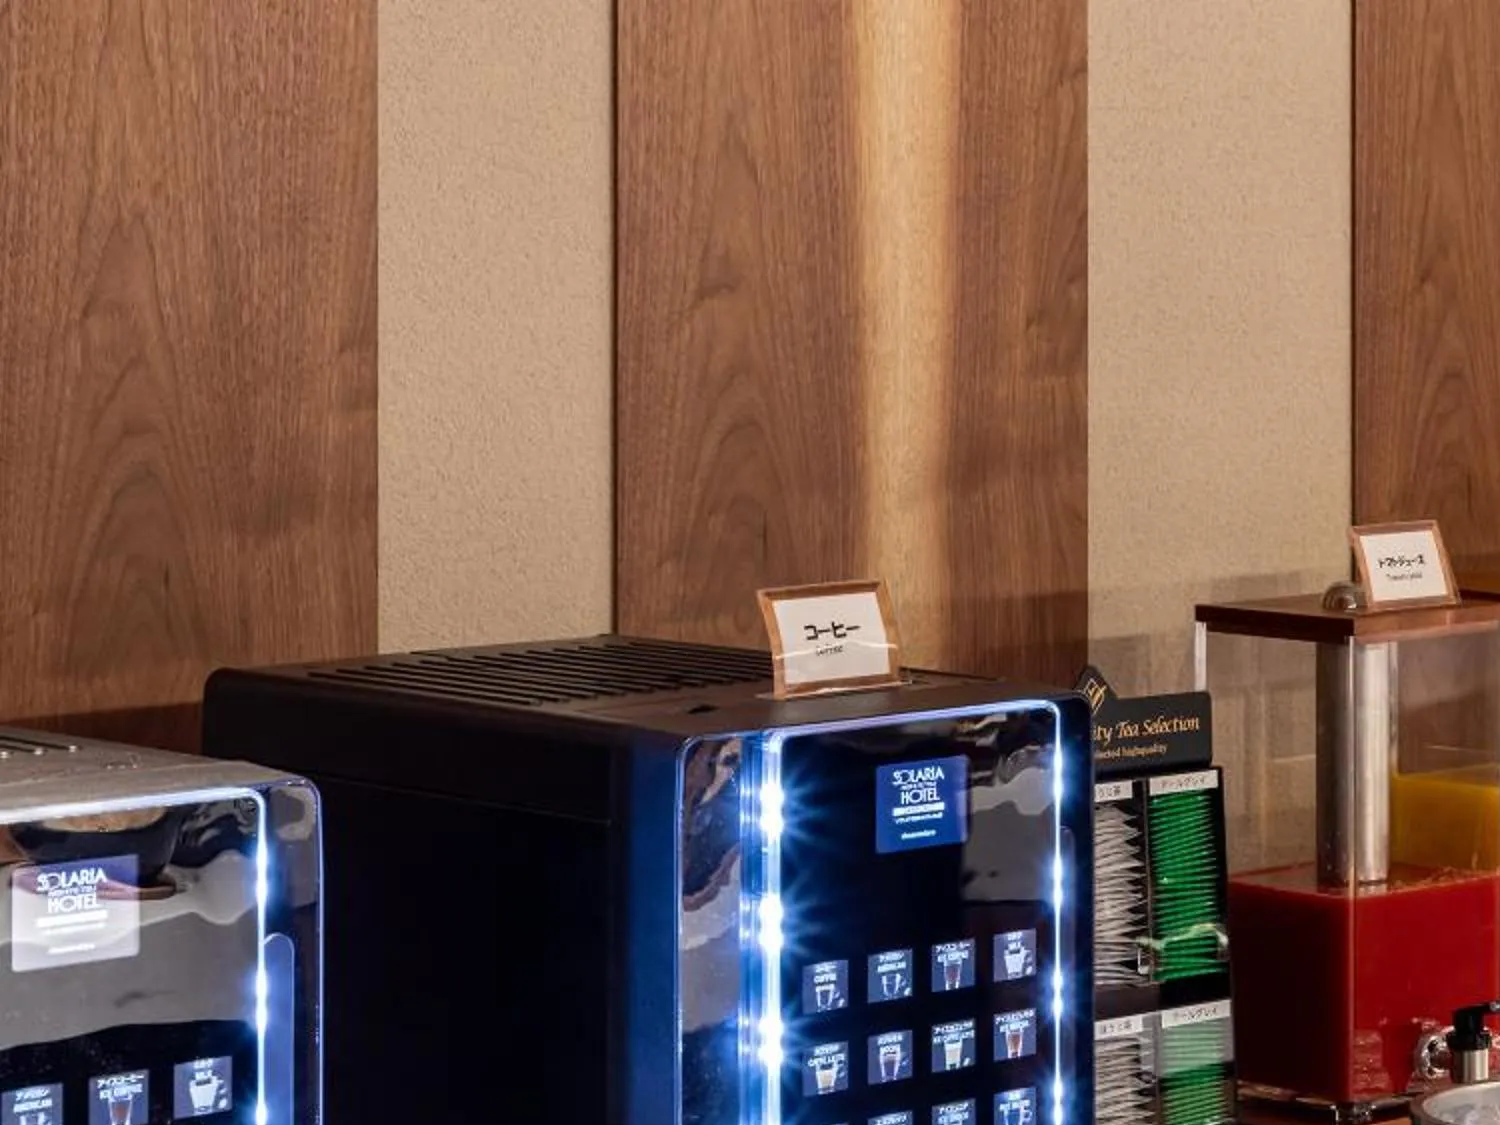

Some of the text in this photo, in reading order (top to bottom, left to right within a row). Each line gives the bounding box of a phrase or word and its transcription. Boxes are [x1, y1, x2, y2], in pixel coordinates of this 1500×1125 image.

[803, 621, 862, 641] コーヒー
[1117, 719, 1140, 739] Tea
[1142, 714, 1200, 736] Selection
[892, 765, 945, 786] SOLARIA
[901, 787, 940, 805] HOTEL
[37, 866, 108, 893] SOLARIA
[47, 893, 100, 914] HOTEL
